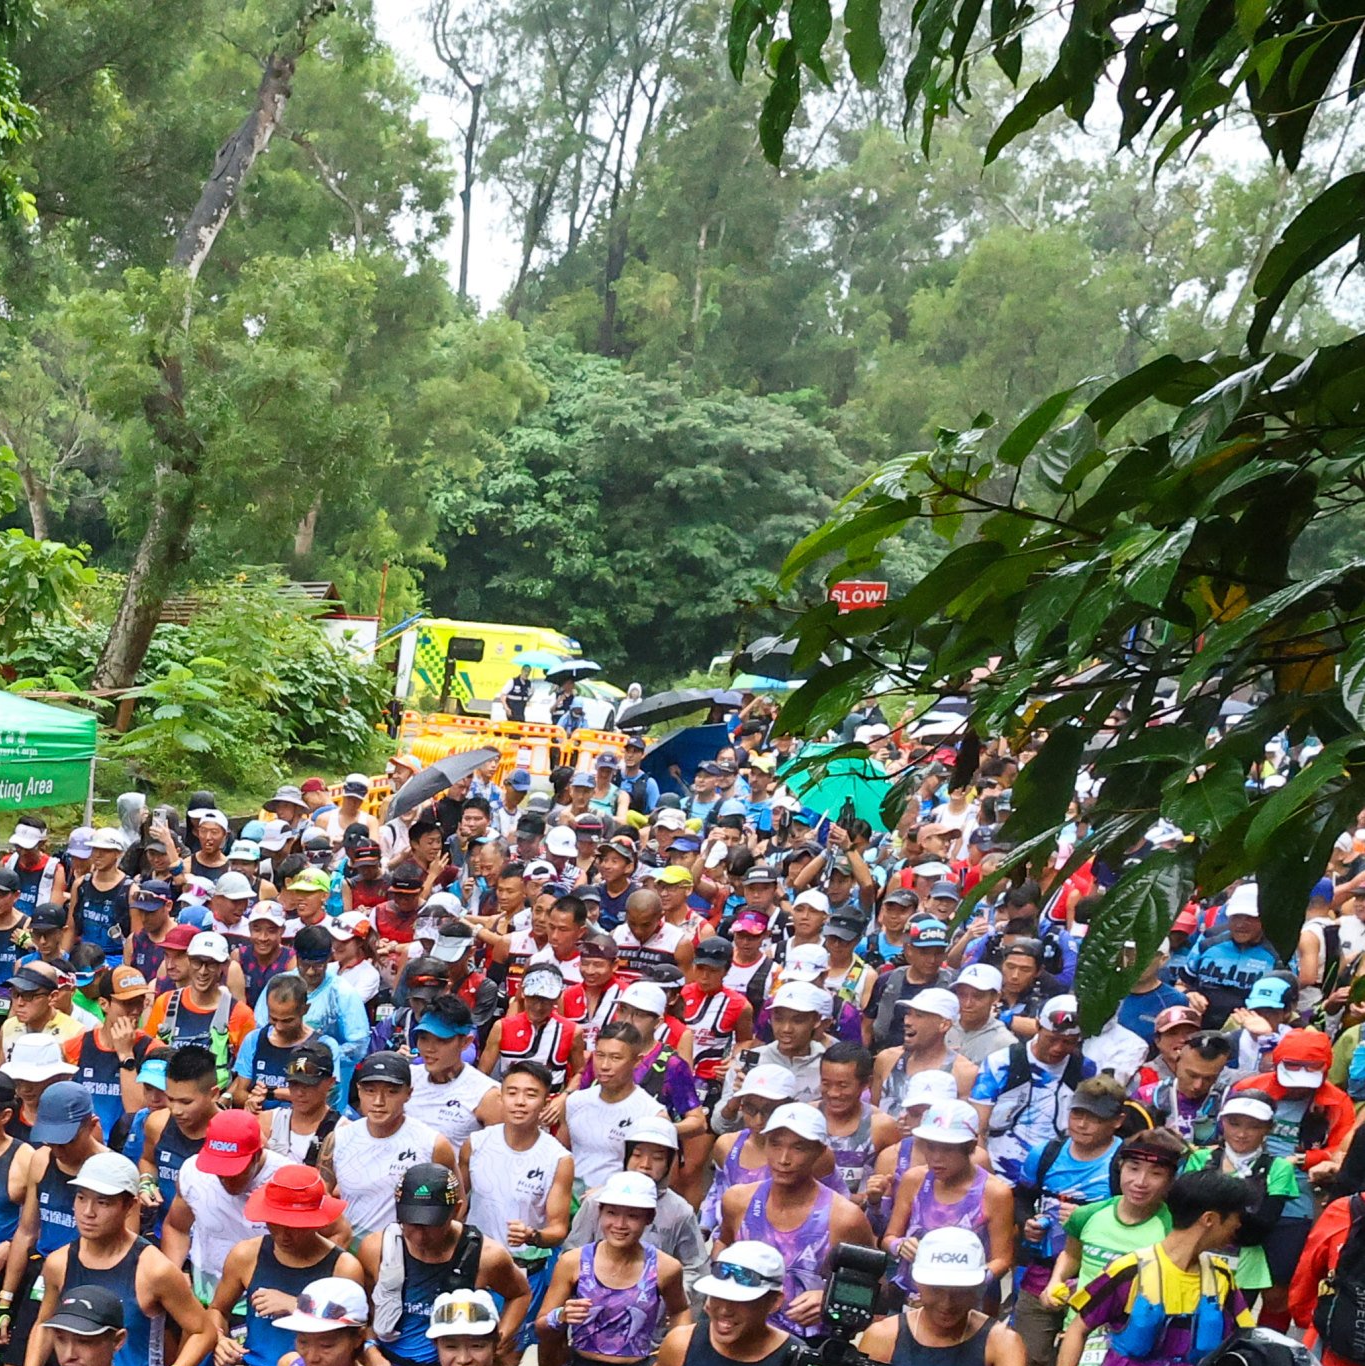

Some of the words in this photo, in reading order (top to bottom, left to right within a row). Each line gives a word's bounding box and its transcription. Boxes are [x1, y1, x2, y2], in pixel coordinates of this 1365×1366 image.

[831, 589, 883, 603] SLOW
[25, 779, 54, 797] Area
[920, 928, 946, 941] ciele
[208, 1139, 239, 1153] HOKA
[930, 1252, 970, 1265] HOKA
